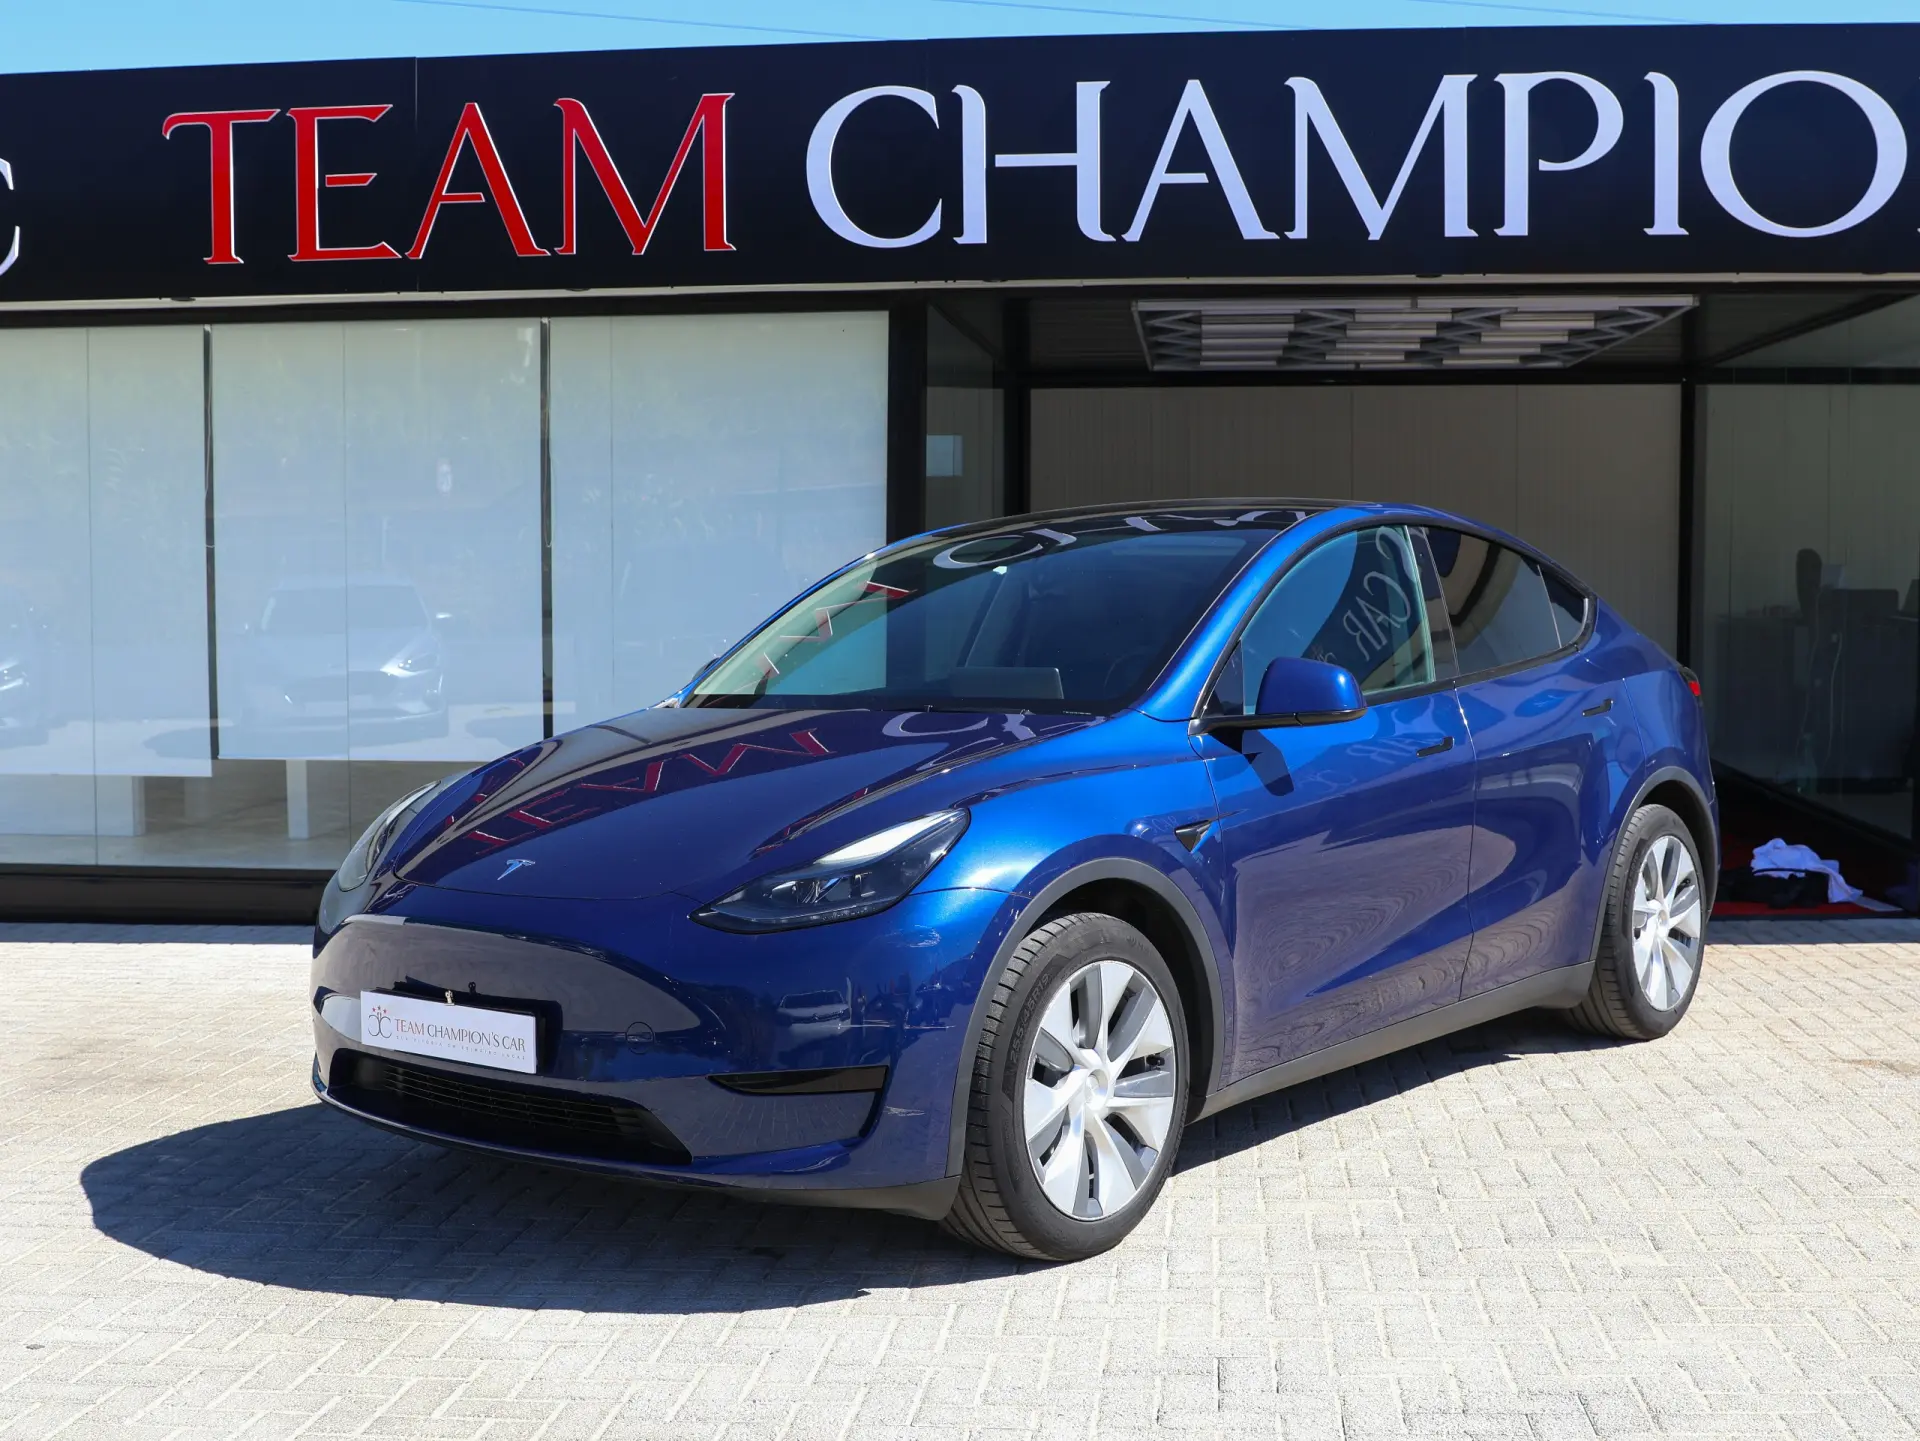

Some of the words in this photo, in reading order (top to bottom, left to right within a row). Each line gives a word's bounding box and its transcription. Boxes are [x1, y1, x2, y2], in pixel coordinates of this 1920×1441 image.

[162, 92, 736, 265] TEAM
[806, 69, 1920, 248] CHAMPIO
[394, 1018, 425, 1036] TEAM
[427, 1023, 500, 1048] CHAMPION'S
[502, 1036, 526, 1053] CAR
